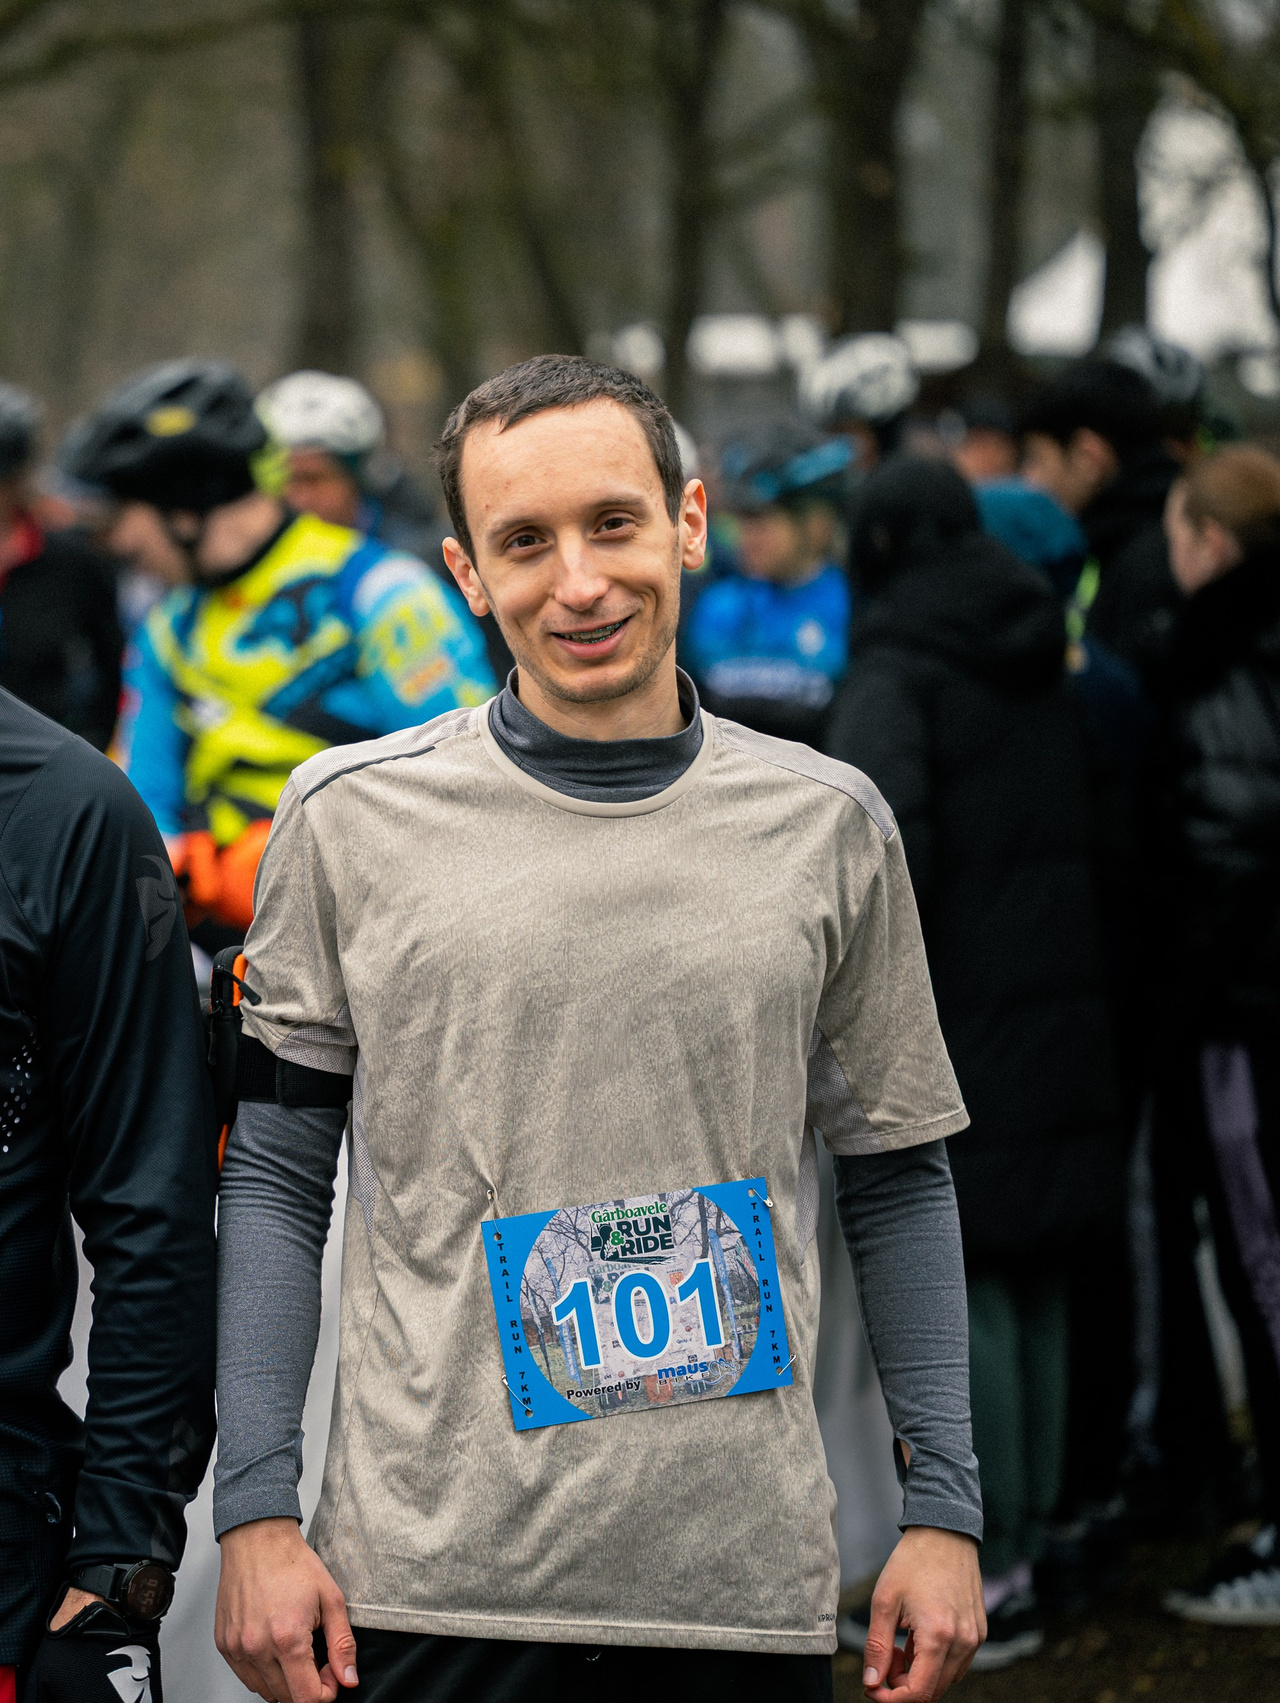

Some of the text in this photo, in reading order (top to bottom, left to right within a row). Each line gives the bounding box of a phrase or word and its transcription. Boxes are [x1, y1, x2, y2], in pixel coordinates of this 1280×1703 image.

[591, 1201, 668, 1223] Gârboavele
[616, 1215, 672, 1237] RUN
[610, 1231, 625, 1246] &
[621, 1232, 675, 1257] RIDE
[751, 1202, 765, 1261] TRAIL
[762, 1279, 773, 1312] RUN
[497, 1243, 513, 1302] TRAIL
[510, 1320, 522, 1354] RUN
[553, 1259, 724, 1369] 101
[657, 1361, 709, 1380] maus
[566, 1380, 641, 1399] Powered by
